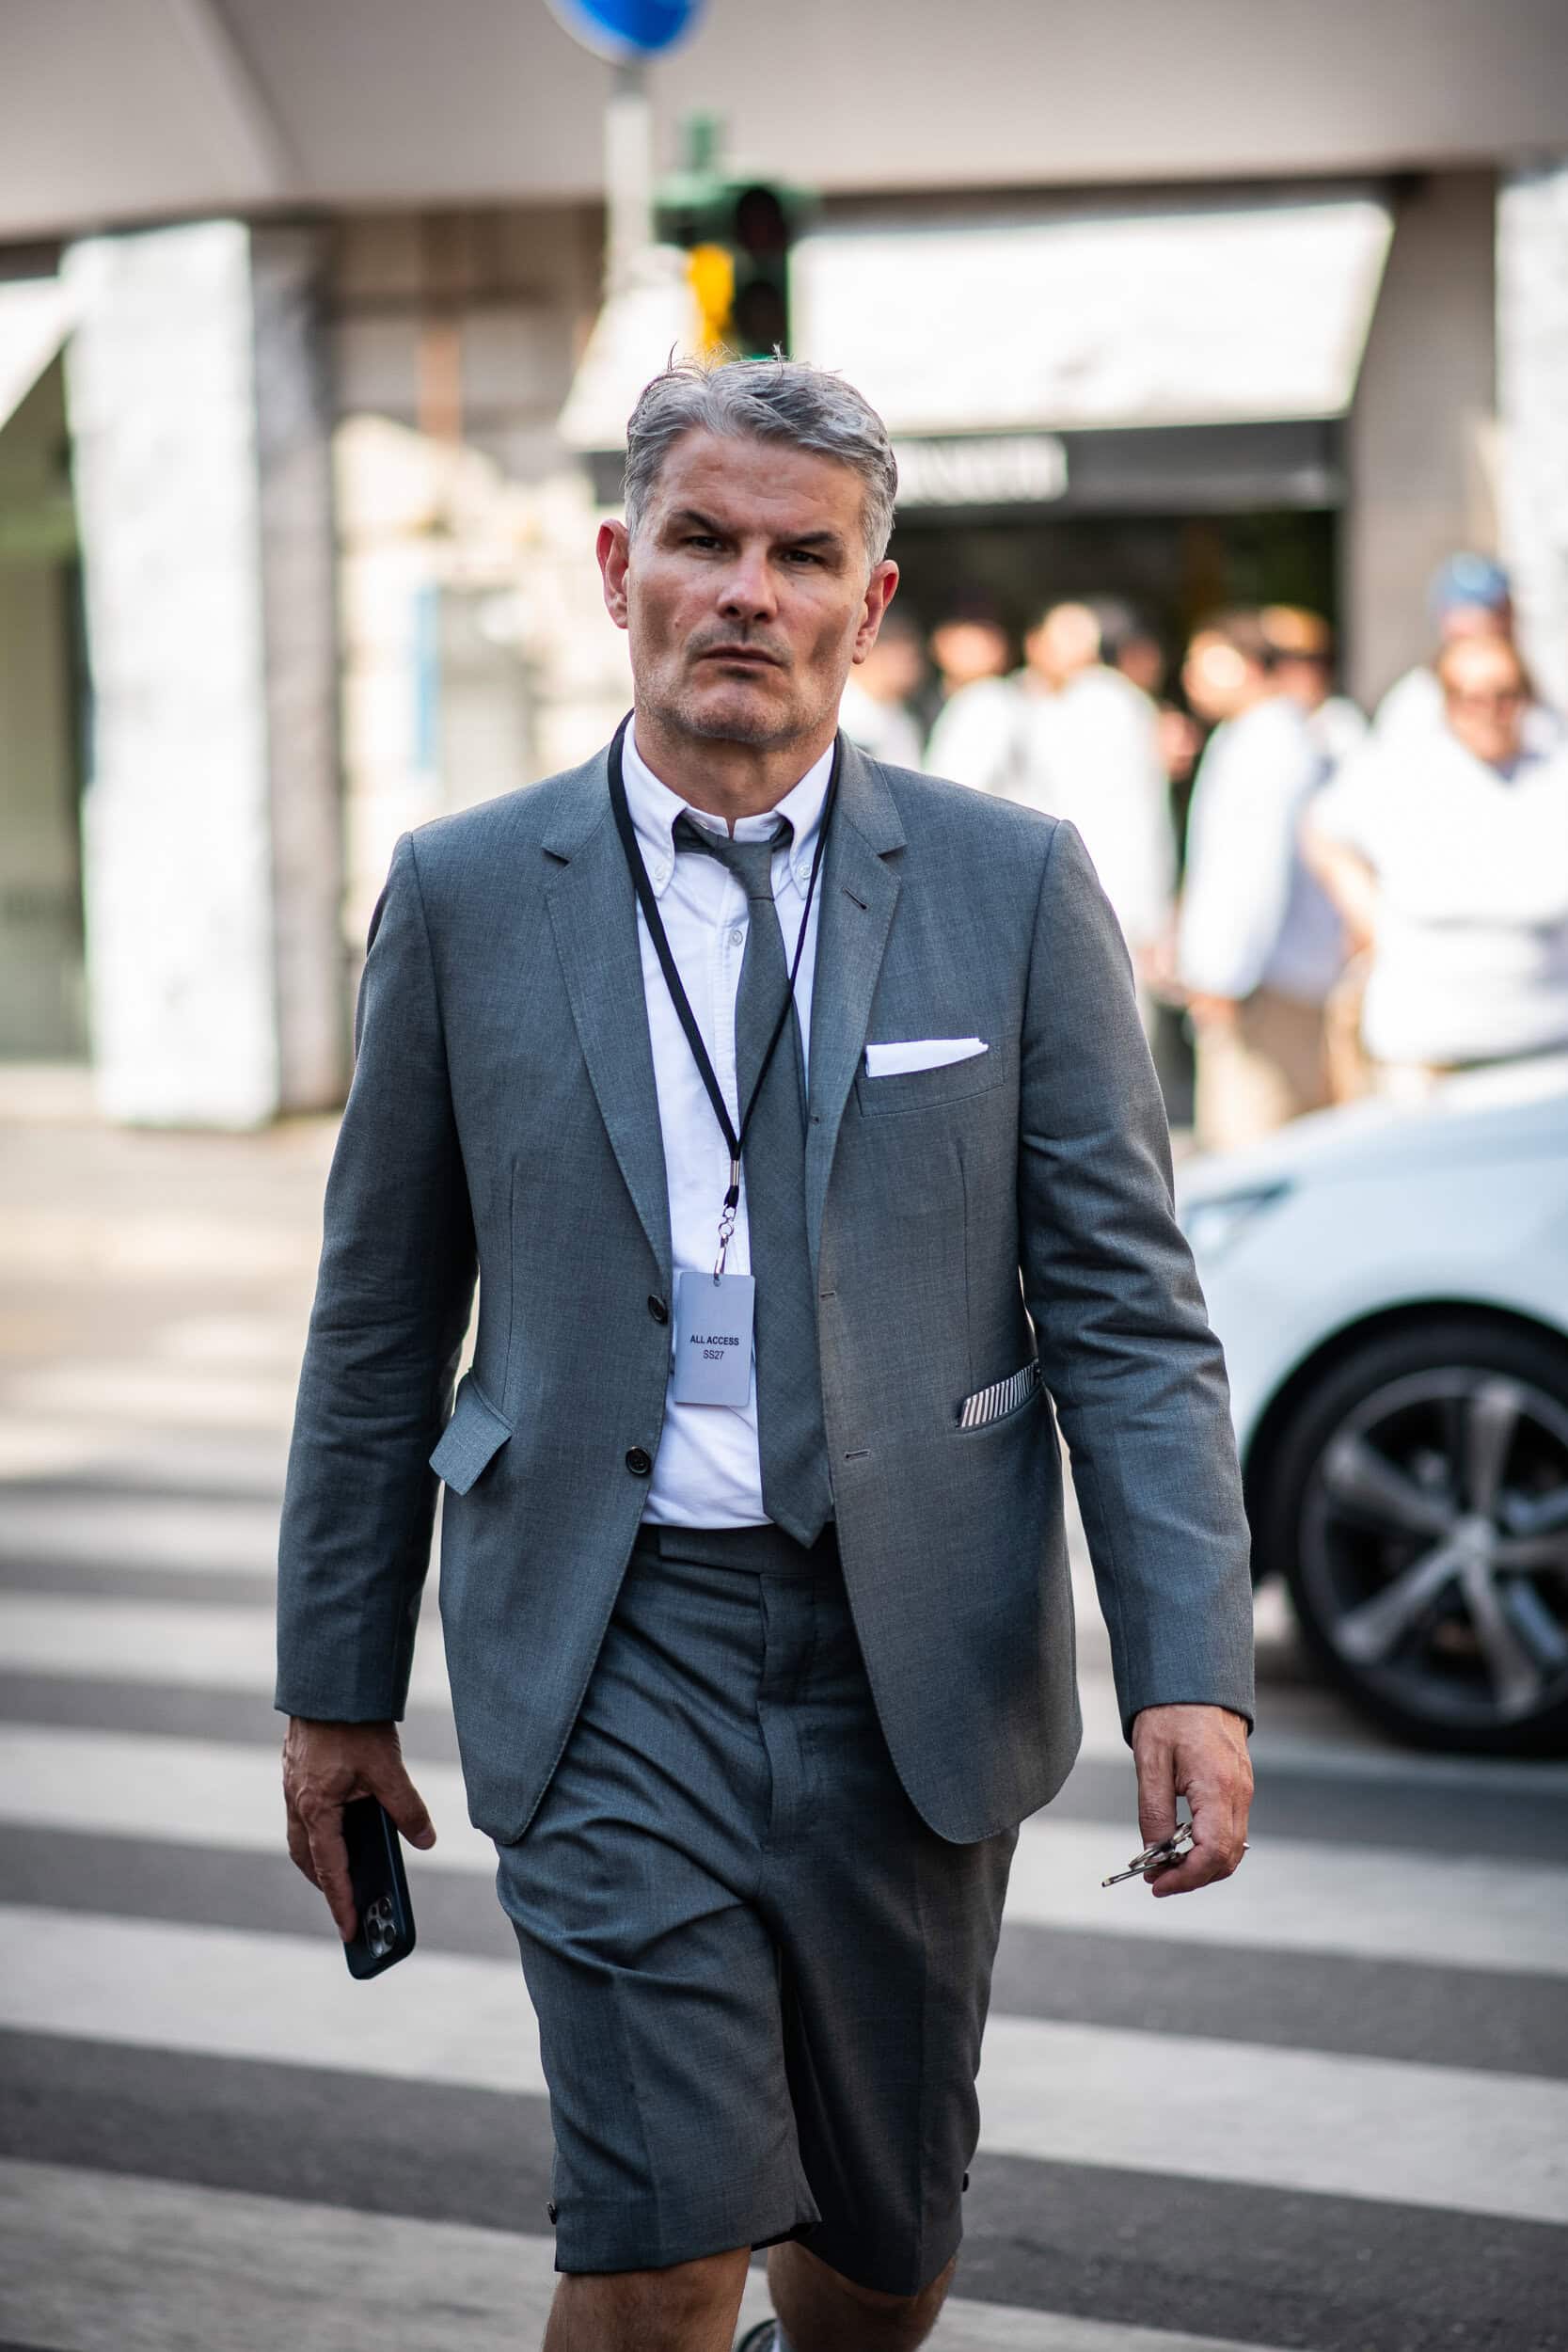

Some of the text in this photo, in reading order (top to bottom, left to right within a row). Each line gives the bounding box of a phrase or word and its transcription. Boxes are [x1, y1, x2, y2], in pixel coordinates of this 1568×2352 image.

[690, 1335, 739, 1345] ALL ACCESS
[703, 1349, 724, 1360] SS27
